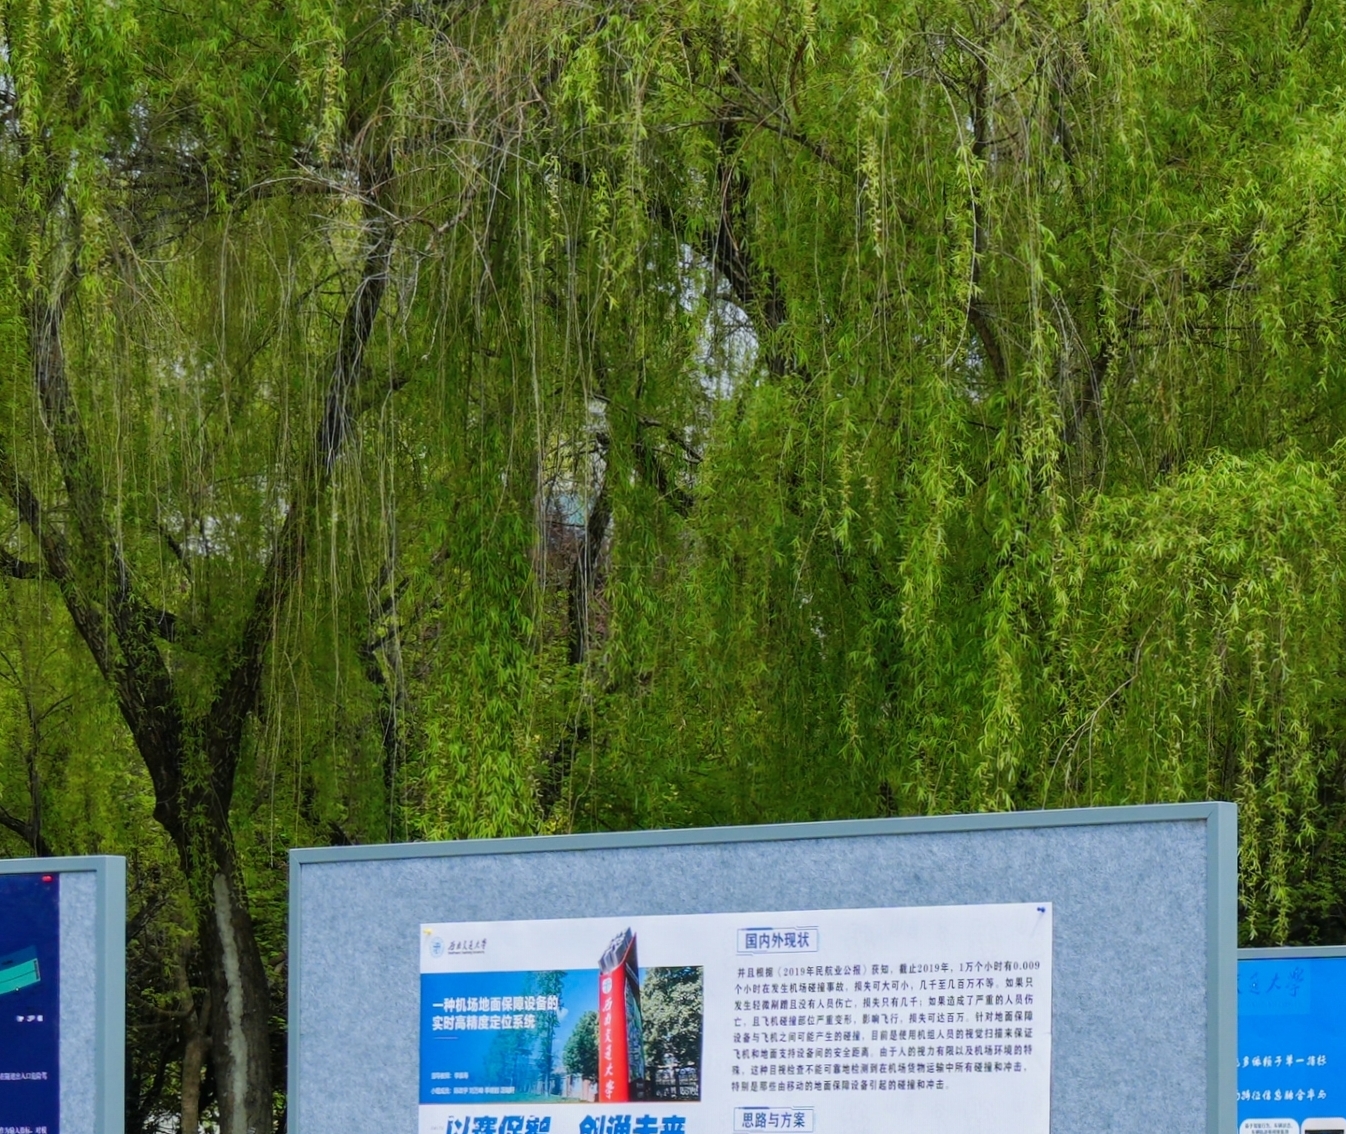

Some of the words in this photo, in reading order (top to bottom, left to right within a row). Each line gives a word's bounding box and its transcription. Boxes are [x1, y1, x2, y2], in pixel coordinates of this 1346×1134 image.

[745, 931, 810, 949] 国内外现状
[433, 995, 559, 1012] 一种机场地面保障设备的
[432, 1013, 536, 1031] 实时高精度定位系统
[742, 1112, 806, 1129] 思路与方案
